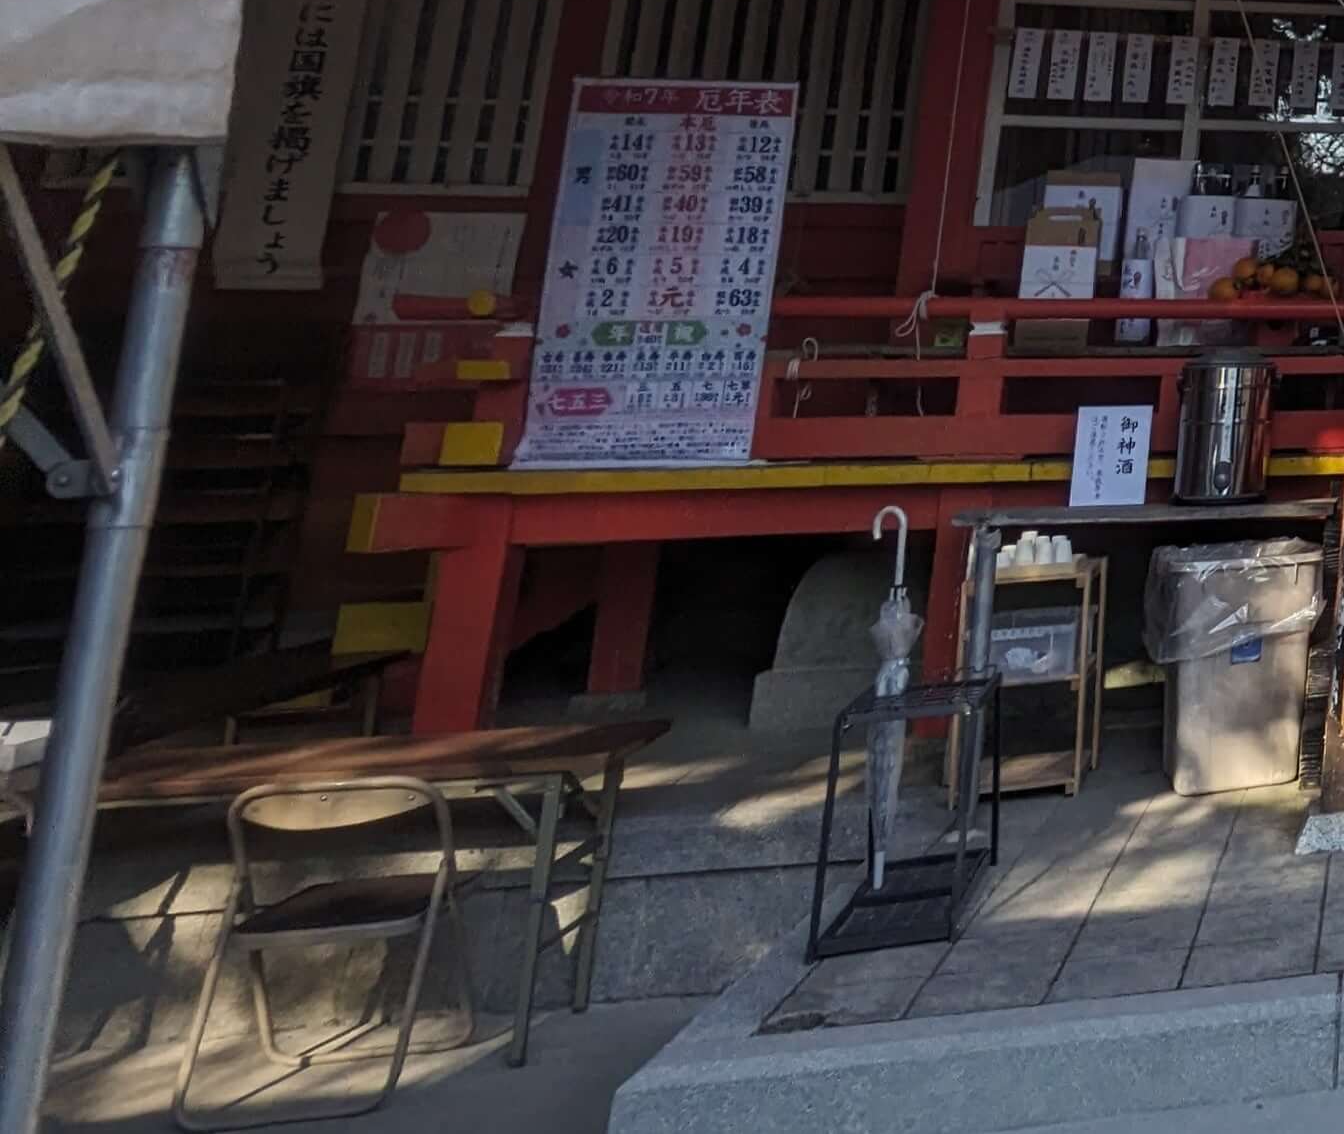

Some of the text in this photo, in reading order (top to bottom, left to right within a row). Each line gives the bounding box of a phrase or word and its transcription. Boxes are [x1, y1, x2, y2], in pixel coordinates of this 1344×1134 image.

[695, 89, 784, 114] 厄年表
[548, 393, 608, 411] 七五三
[1115, 416, 1138, 475] 御神酒
